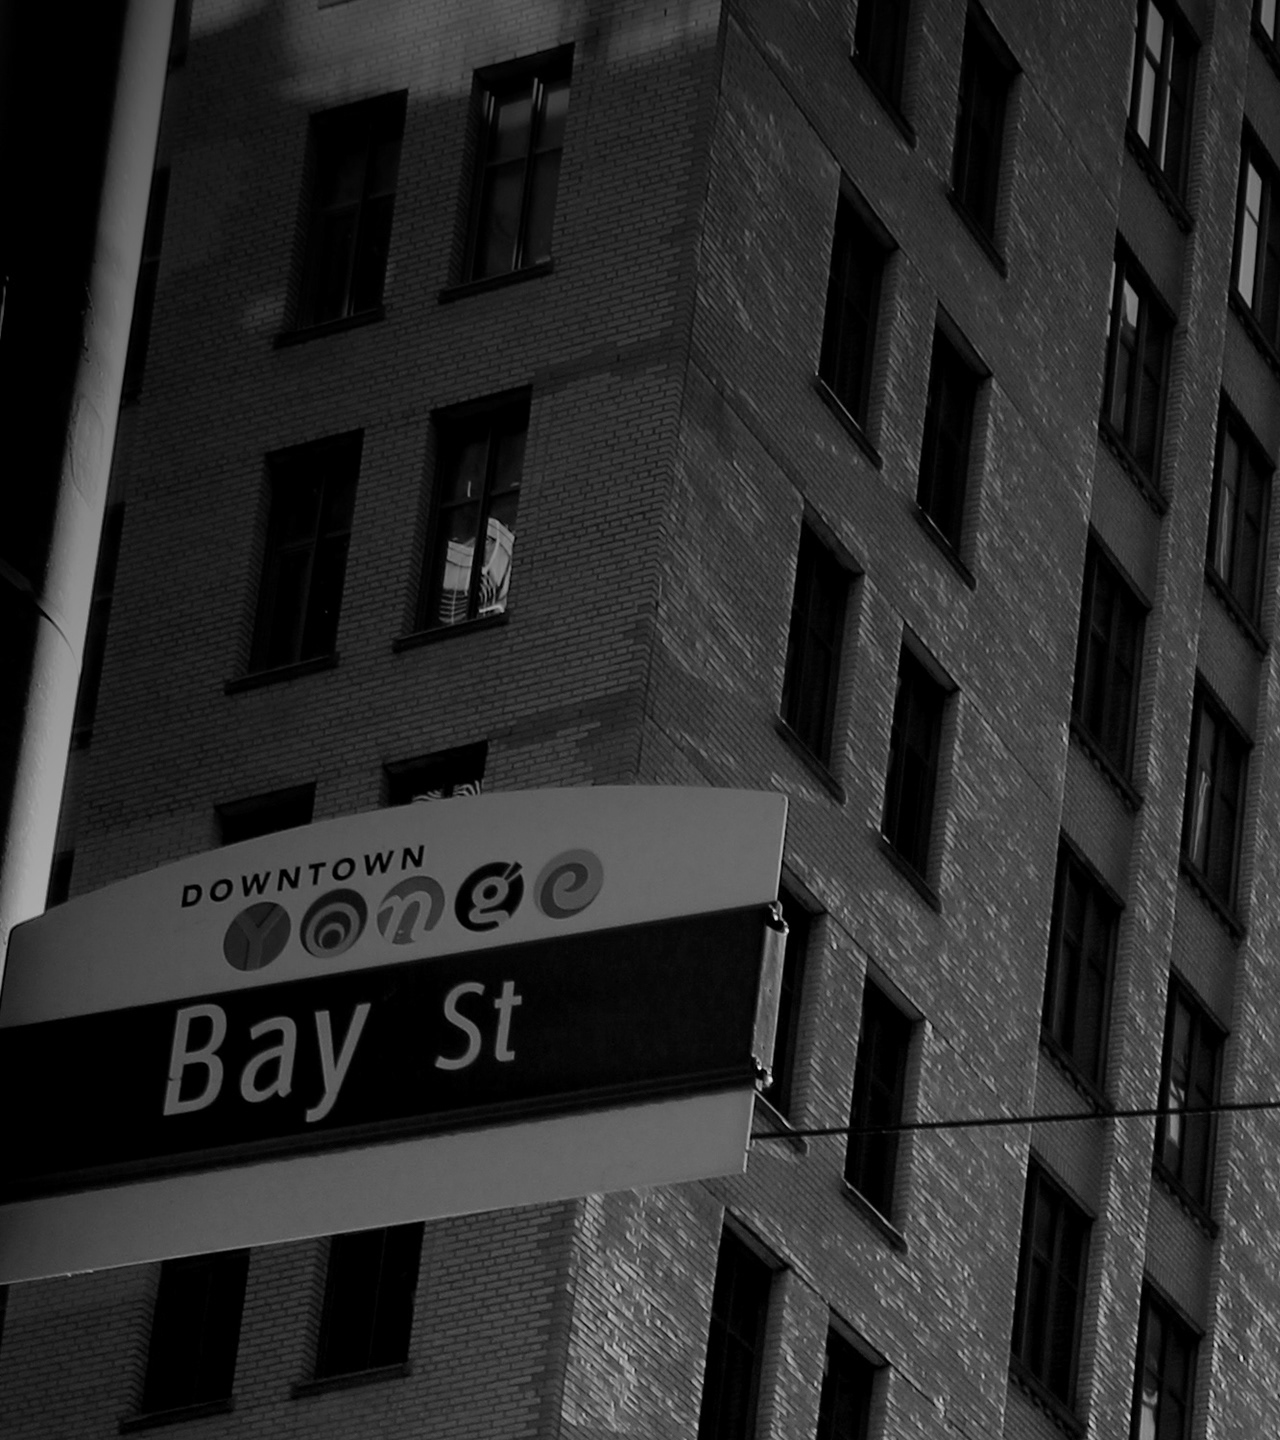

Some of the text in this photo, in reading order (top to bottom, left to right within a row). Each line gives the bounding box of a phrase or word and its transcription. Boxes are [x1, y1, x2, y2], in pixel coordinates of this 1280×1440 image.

[181, 845, 426, 908] DOWNTOWN
[163, 980, 523, 1123] Bay St
